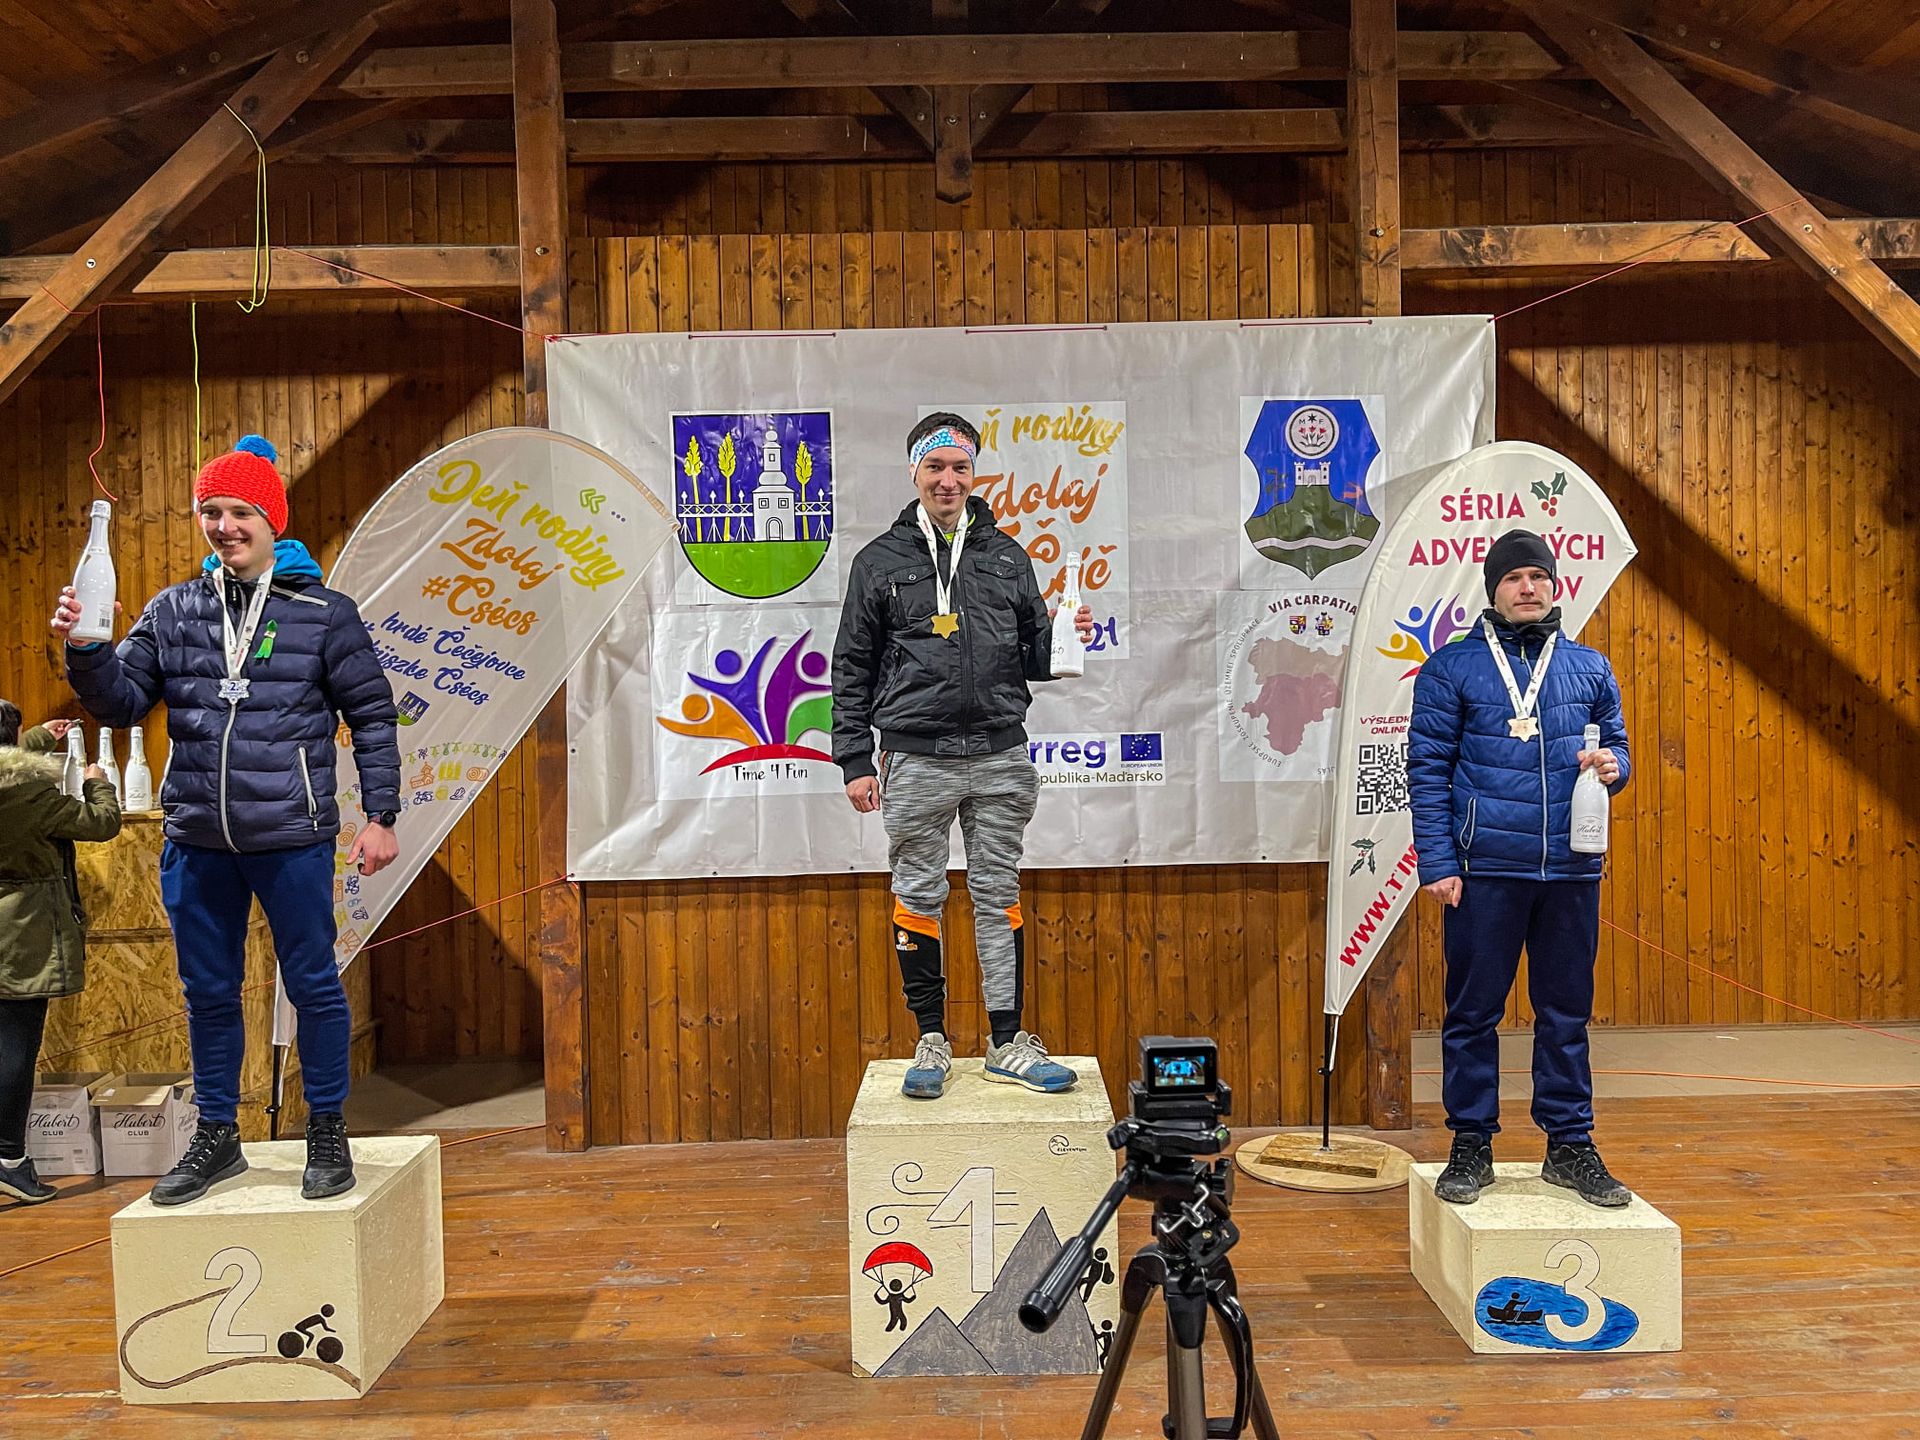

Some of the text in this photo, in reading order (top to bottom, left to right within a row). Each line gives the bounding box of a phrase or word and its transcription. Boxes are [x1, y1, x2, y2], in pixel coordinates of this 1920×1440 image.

[1012, 405, 1124, 456] rodiny
[428, 460, 625, 591] Deň rodiny
[1440, 487, 1525, 522] SÉRIA
[441, 518, 564, 590] Zdolaj
[1408, 526, 1605, 566] ADVEÝCH
[422, 574, 539, 635] #Csécs
[1268, 595, 1358, 616] VIA CARPATIA
[373, 640, 489, 705] üszke Csécs
[433, 625, 526, 681] Čečejovce
[1360, 715, 1410, 725] VÝSLEDK
[1370, 725, 1407, 735] ONLINE
[732, 762, 808, 781] Time 4 Fun
[1029, 741, 1106, 769] rreg
[1040, 770, 1163, 786] publika-Maďarsko
[1339, 843, 1419, 968] WWW.TIM
[29, 1112, 80, 1131] Hubert
[113, 1112, 166, 1131] Hubert
[927, 1167, 994, 1292] 1
[204, 1246, 267, 1353] 2
[1544, 1238, 1607, 1342] 3
